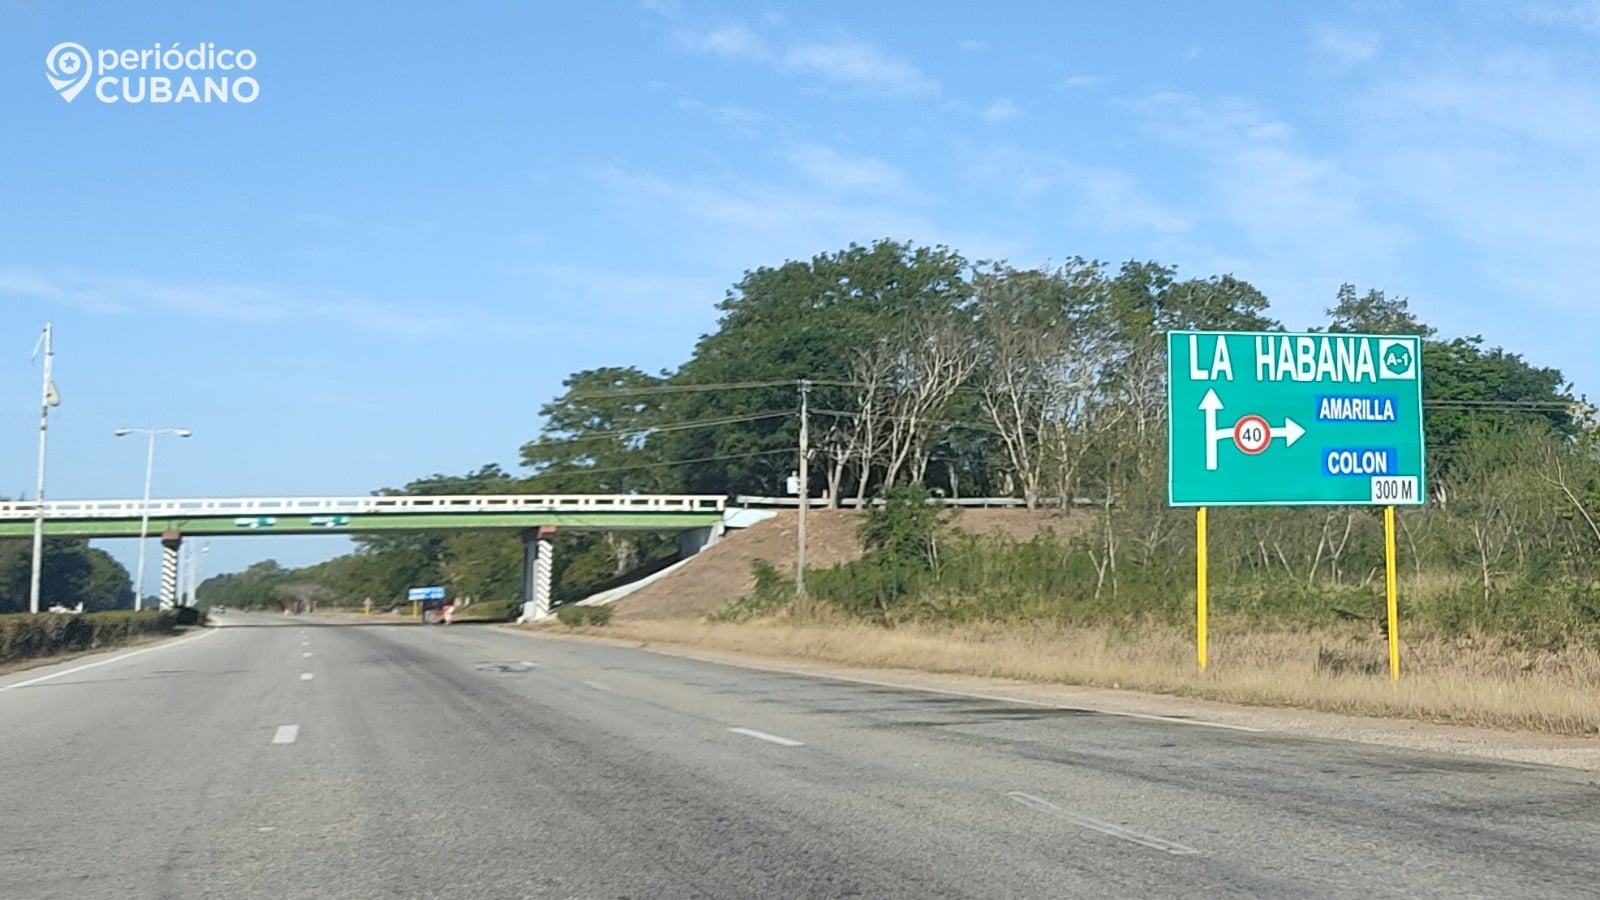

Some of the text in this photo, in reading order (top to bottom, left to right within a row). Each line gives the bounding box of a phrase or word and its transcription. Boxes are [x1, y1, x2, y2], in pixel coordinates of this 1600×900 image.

[1189, 335, 1377, 382] LA HABANA
[1386, 353, 1409, 366] A-1
[1319, 398, 1395, 421] AMARILLA
[1242, 427, 1262, 442] 40
[1327, 451, 1387, 474] COLON
[1375, 480, 1412, 499] 300 M
